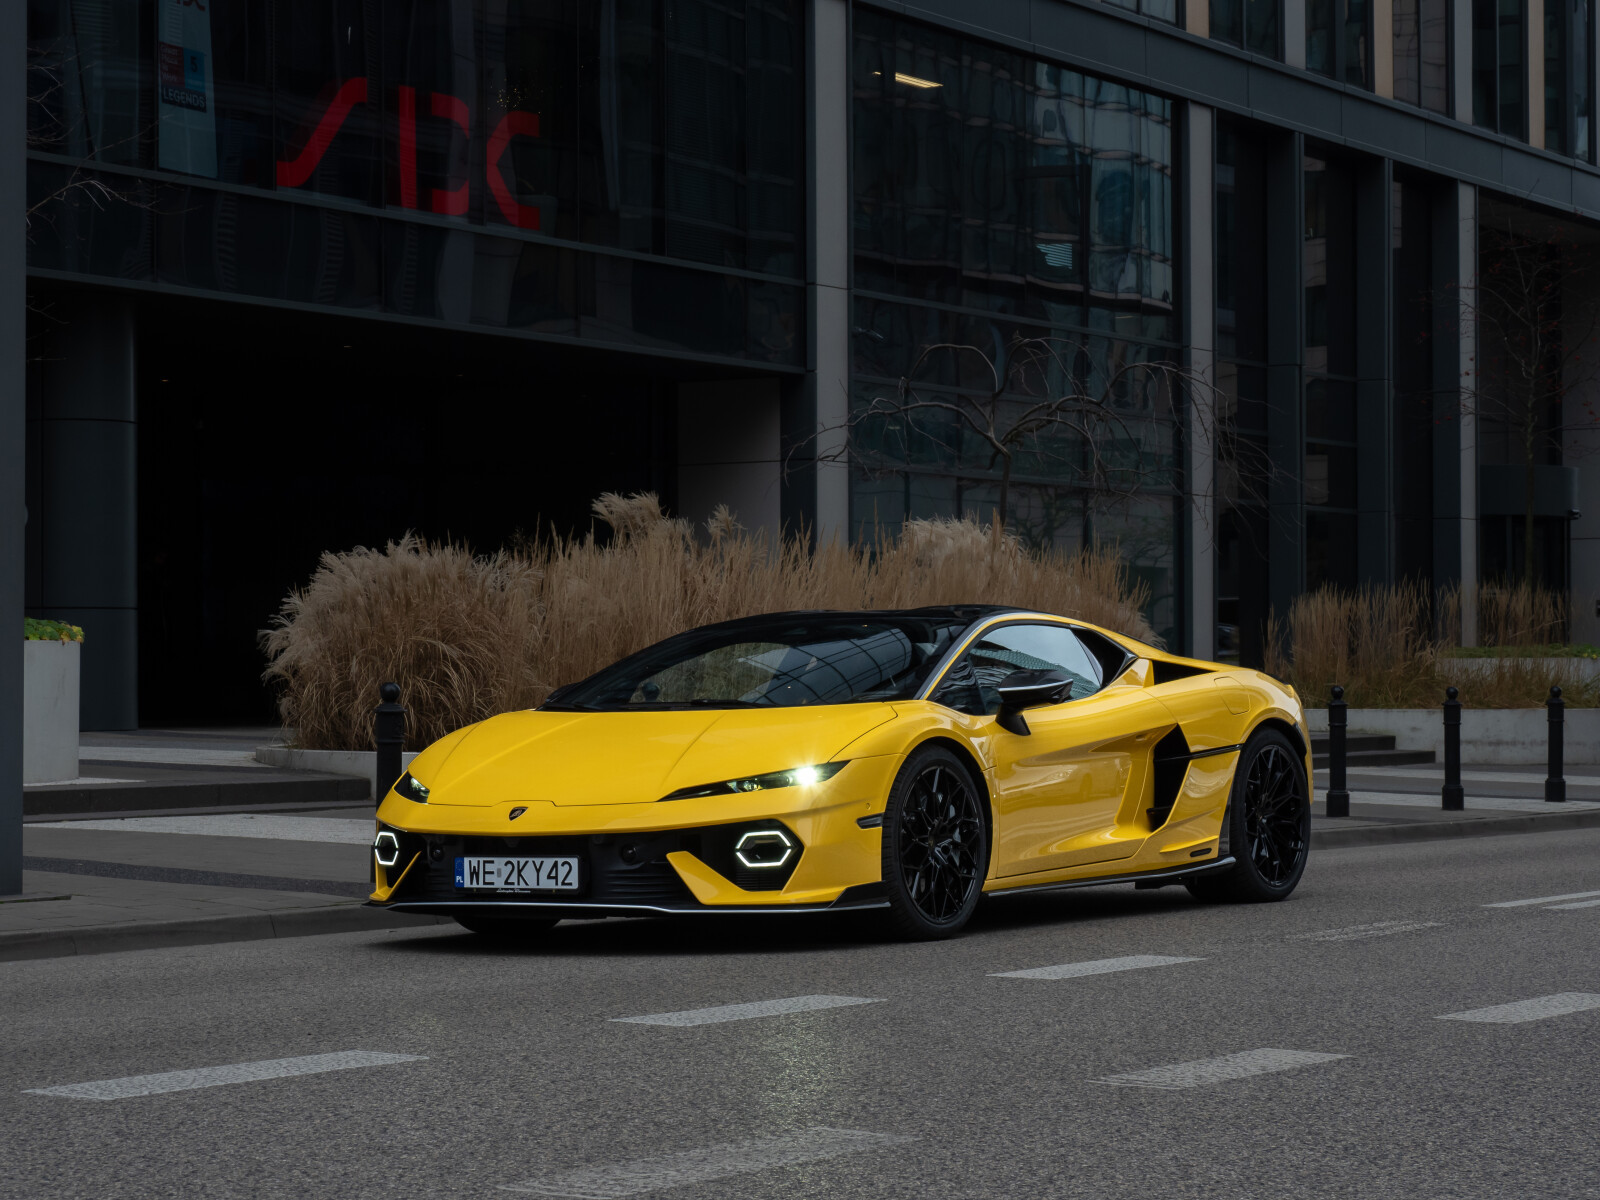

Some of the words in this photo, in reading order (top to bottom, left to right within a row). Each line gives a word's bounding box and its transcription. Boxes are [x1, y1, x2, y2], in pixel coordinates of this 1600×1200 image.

[163, 87, 205, 108] LEGENDS
[456, 875, 464, 883] PL
[469, 860, 495, 886] WE
[504, 860, 573, 886] 2KY42
